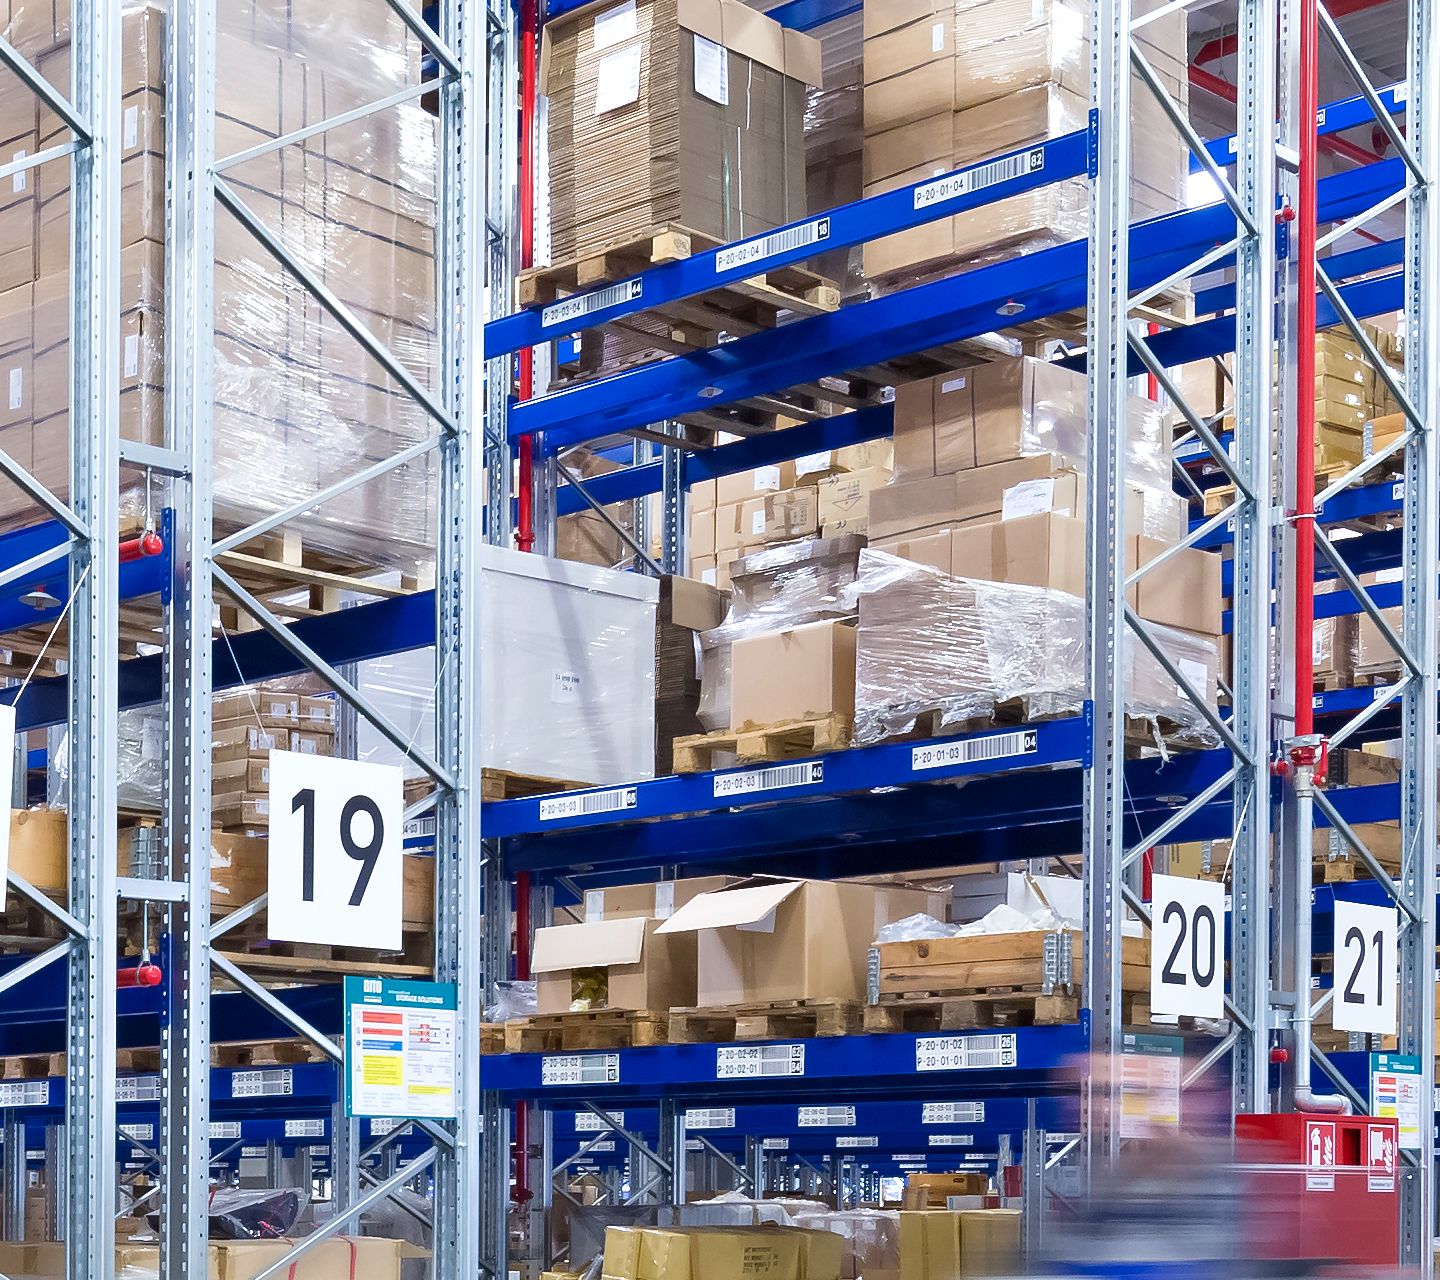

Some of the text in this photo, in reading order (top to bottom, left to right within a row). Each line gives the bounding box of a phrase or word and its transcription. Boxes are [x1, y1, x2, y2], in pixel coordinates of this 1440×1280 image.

[916, 152, 1043, 205] P-20-01-04 82
[717, 221, 828, 268] P-20-02-04 18
[543, 281, 642, 323] P-20-03-04 44
[913, 734, 1037, 766] P-20-01-03 04
[715, 765, 822, 793] P-20-02-03 40
[541, 800, 577, 816] P-20-03-03
[291, 788, 384, 907] 19
[1161, 901, 1216, 989] 20
[1343, 926, 1384, 1006] 21
[363, 979, 382, 994] BITO
[718, 1049, 758, 1060] P-20-02-02
[917, 1039, 963, 1051] P-20-01-02
[543, 1057, 578, 1067] P-20-03-02
[718, 1064, 757, 1074] P-20-02-01
[917, 1056, 963, 1067] P-20-01-01
[543, 1072, 578, 1082] P-20-03-01
